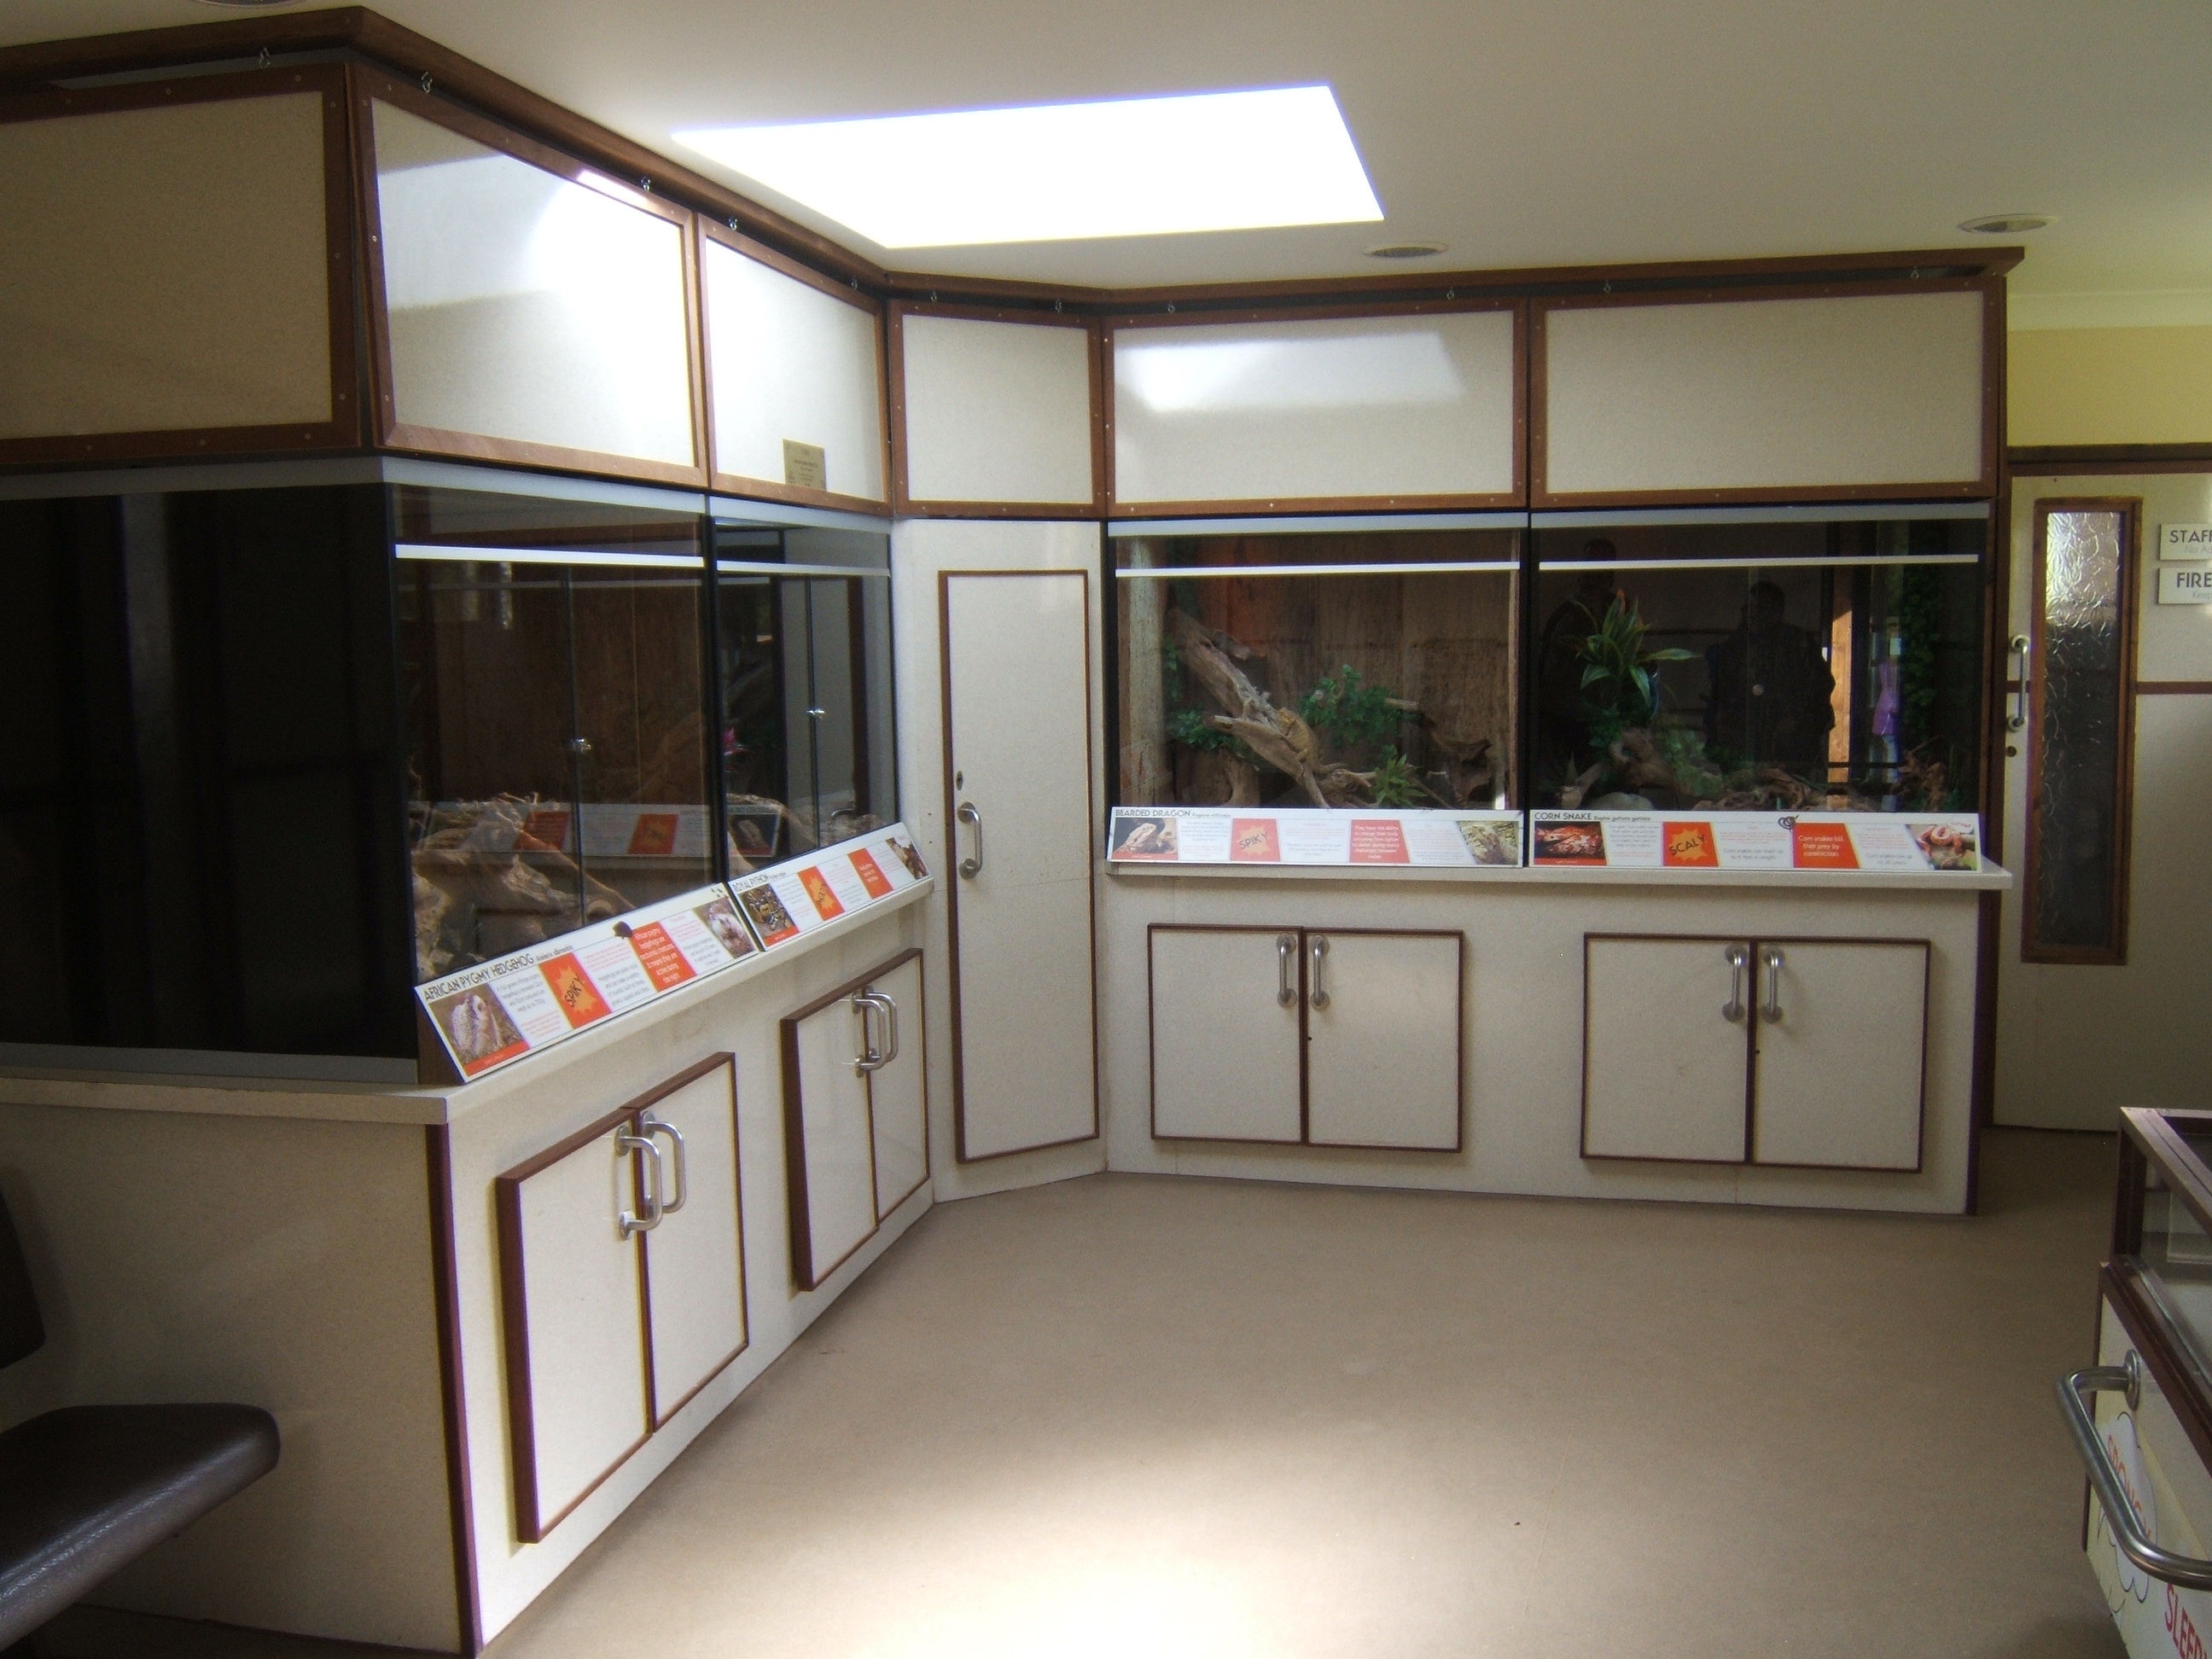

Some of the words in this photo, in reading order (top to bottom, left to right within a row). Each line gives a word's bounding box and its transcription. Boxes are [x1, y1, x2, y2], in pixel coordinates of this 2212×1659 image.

[2176, 572, 2212, 588] FIRE
[1239, 830, 1267, 849] SPIKY
[1669, 835, 1704, 855] SCALY
[423, 977, 461, 1001] AFRICAN
[459, 967, 492, 989] PYGMY
[492, 953, 535, 978] HEDGEHOG
[564, 974, 585, 1007] SPIKY
[2165, 1582, 2209, 1659] SLEE
